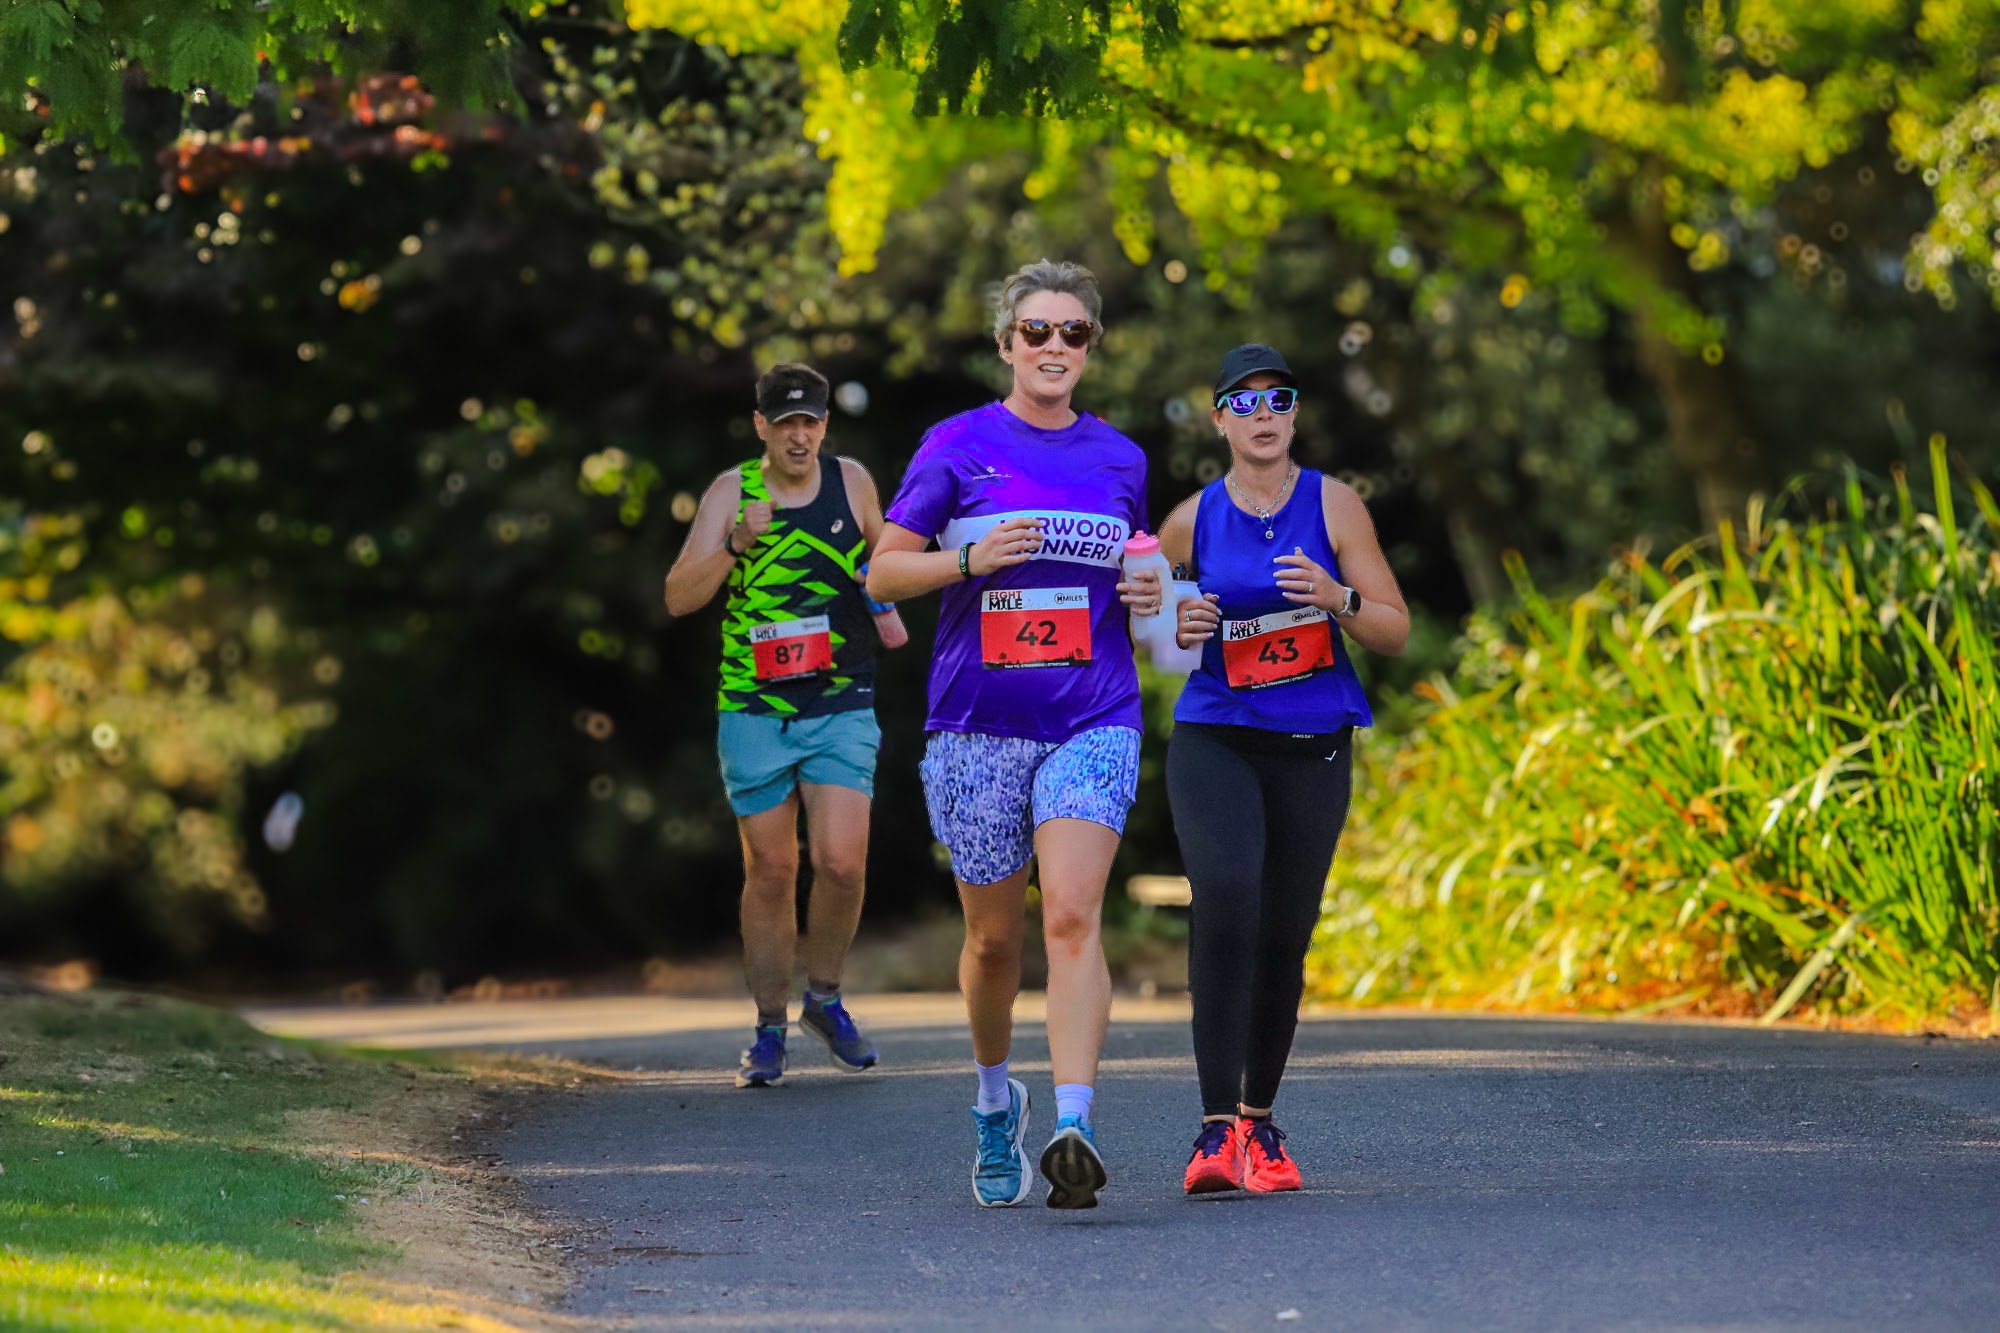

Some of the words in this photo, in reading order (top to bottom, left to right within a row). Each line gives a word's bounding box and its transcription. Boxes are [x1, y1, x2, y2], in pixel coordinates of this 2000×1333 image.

[1000, 517, 1122, 542] RWOOD
[989, 591, 1022, 600] EIGHT
[989, 598, 1023, 610] MILE
[1016, 620, 1059, 646] 42
[1230, 625, 1262, 640] MILE
[775, 643, 804, 665] 87
[1258, 637, 1300, 665] 43
